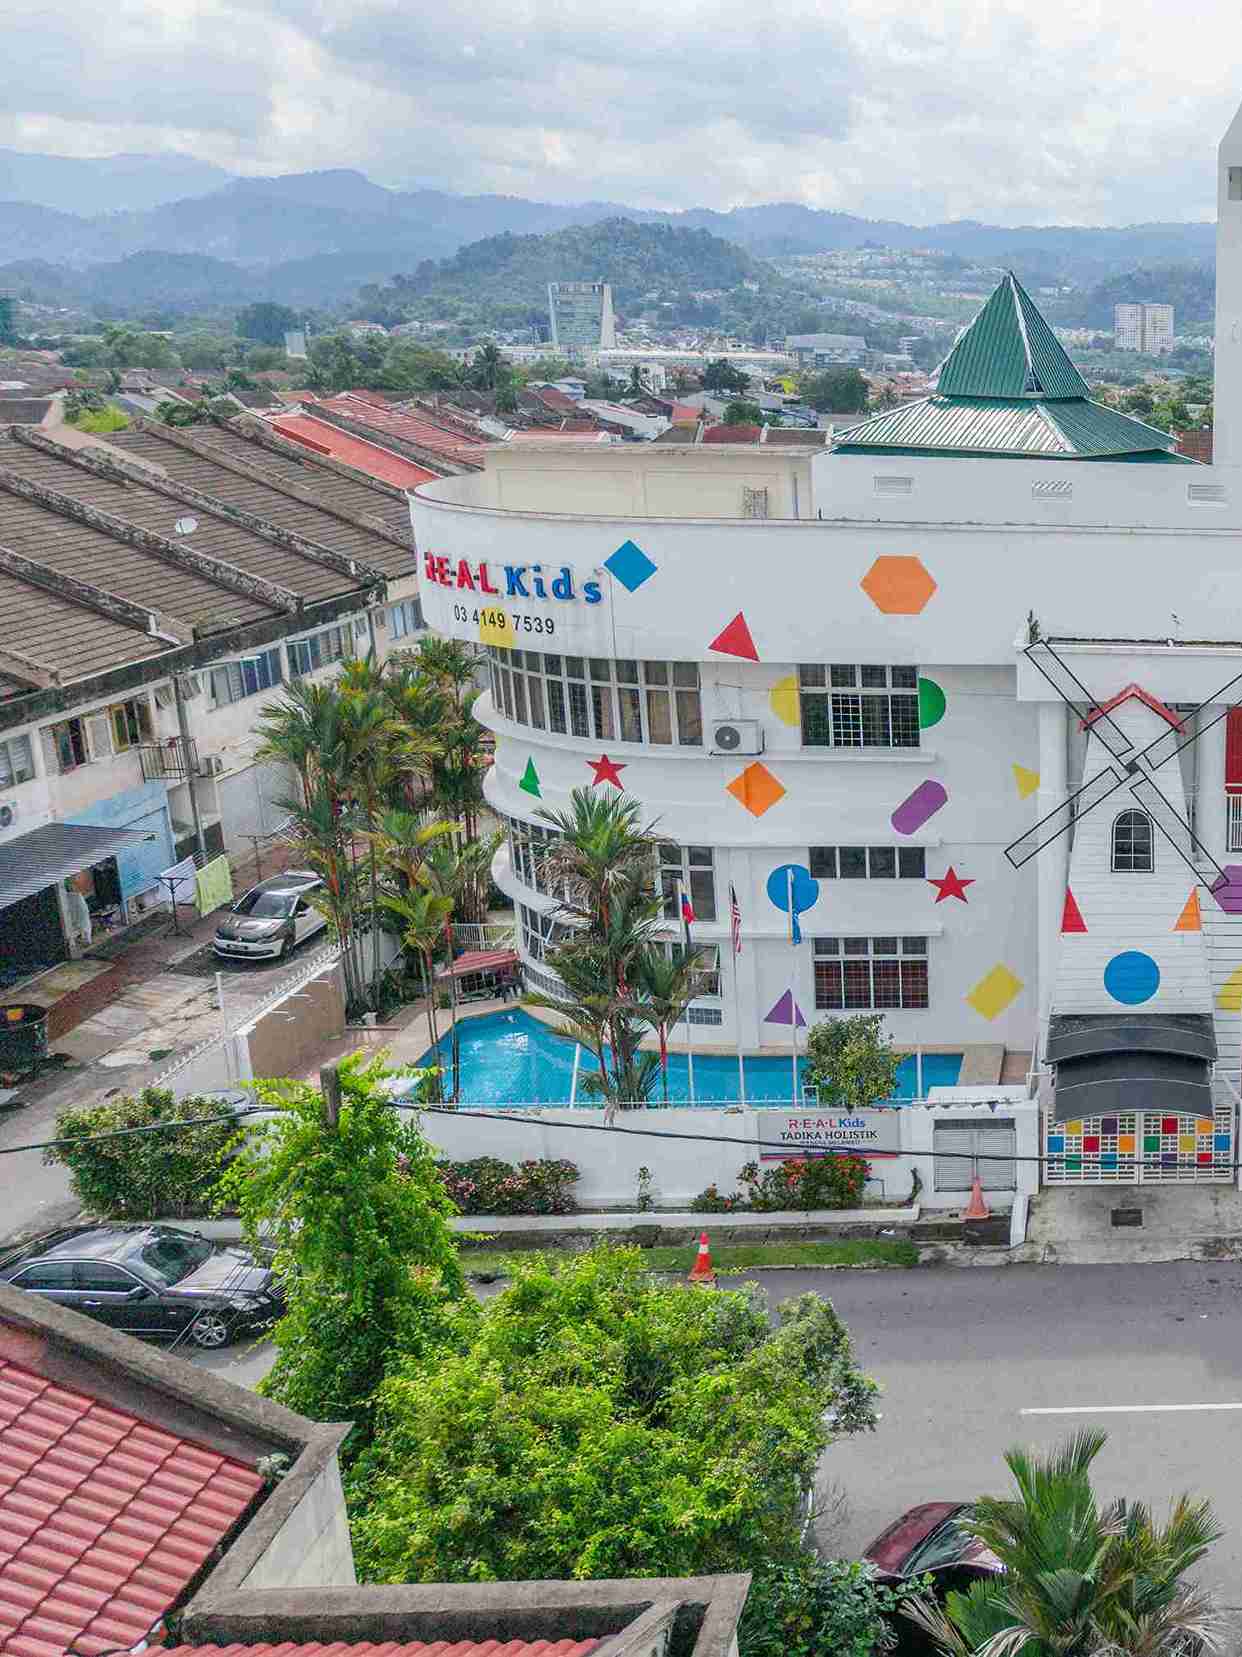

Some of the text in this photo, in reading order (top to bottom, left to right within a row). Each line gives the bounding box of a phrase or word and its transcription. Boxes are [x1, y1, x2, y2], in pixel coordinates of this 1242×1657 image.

[503, 565, 602, 604] Kids
[454, 604, 555, 634] 03 4149 7539
[838, 1118, 866, 1128] Kids
[780, 1130, 878, 1140] TADIKA HOLISTIK
